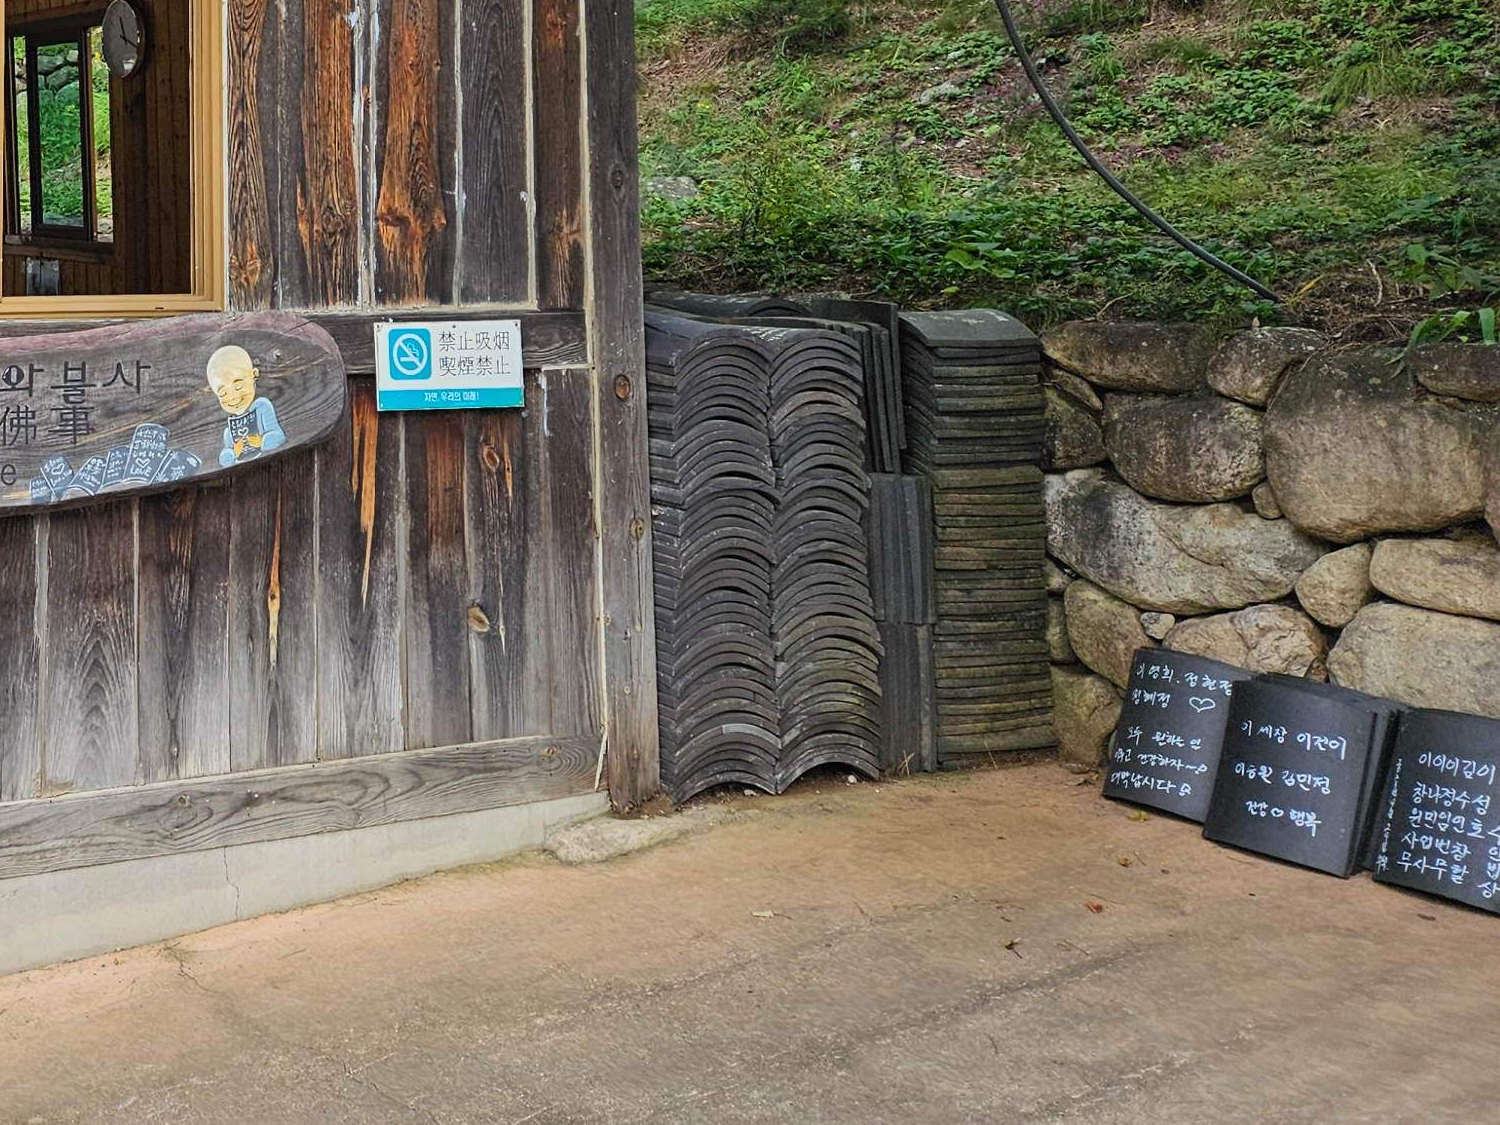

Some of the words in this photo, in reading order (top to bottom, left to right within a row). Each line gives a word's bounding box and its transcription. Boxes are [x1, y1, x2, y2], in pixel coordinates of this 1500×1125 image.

[439, 330, 510, 352] 禁止吸烟
[439, 355, 511, 377] 喫煙禁止
[441, 391, 461, 402] 우리의
[463, 390, 480, 401] 미래!
[1289, 809, 1321, 837] 행복
[1396, 851, 1470, 884] 무사무탈
